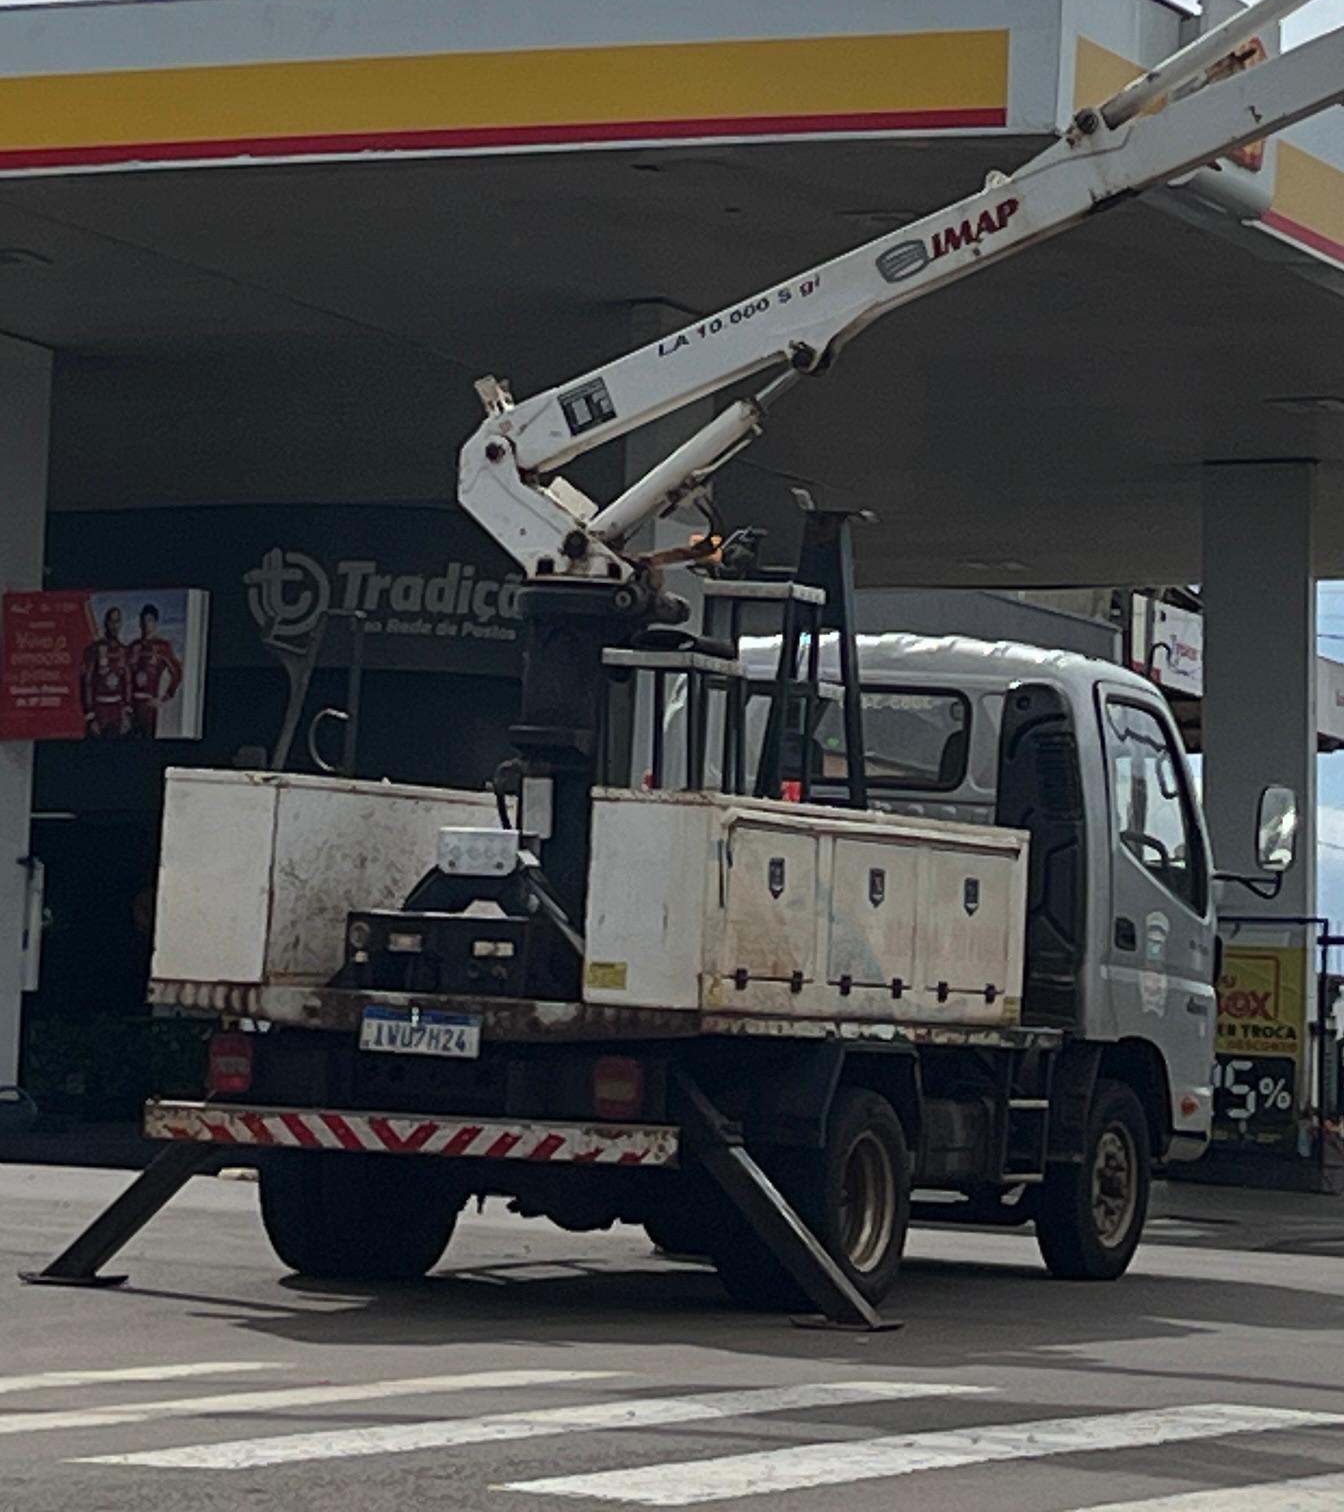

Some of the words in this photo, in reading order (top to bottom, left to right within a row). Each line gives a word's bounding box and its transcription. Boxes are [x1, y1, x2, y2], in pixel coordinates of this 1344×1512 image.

[931, 198, 1020, 259] IMAP
[337, 560, 524, 622] Tradiçã
[1242, 1024, 1297, 1040] TROCA
